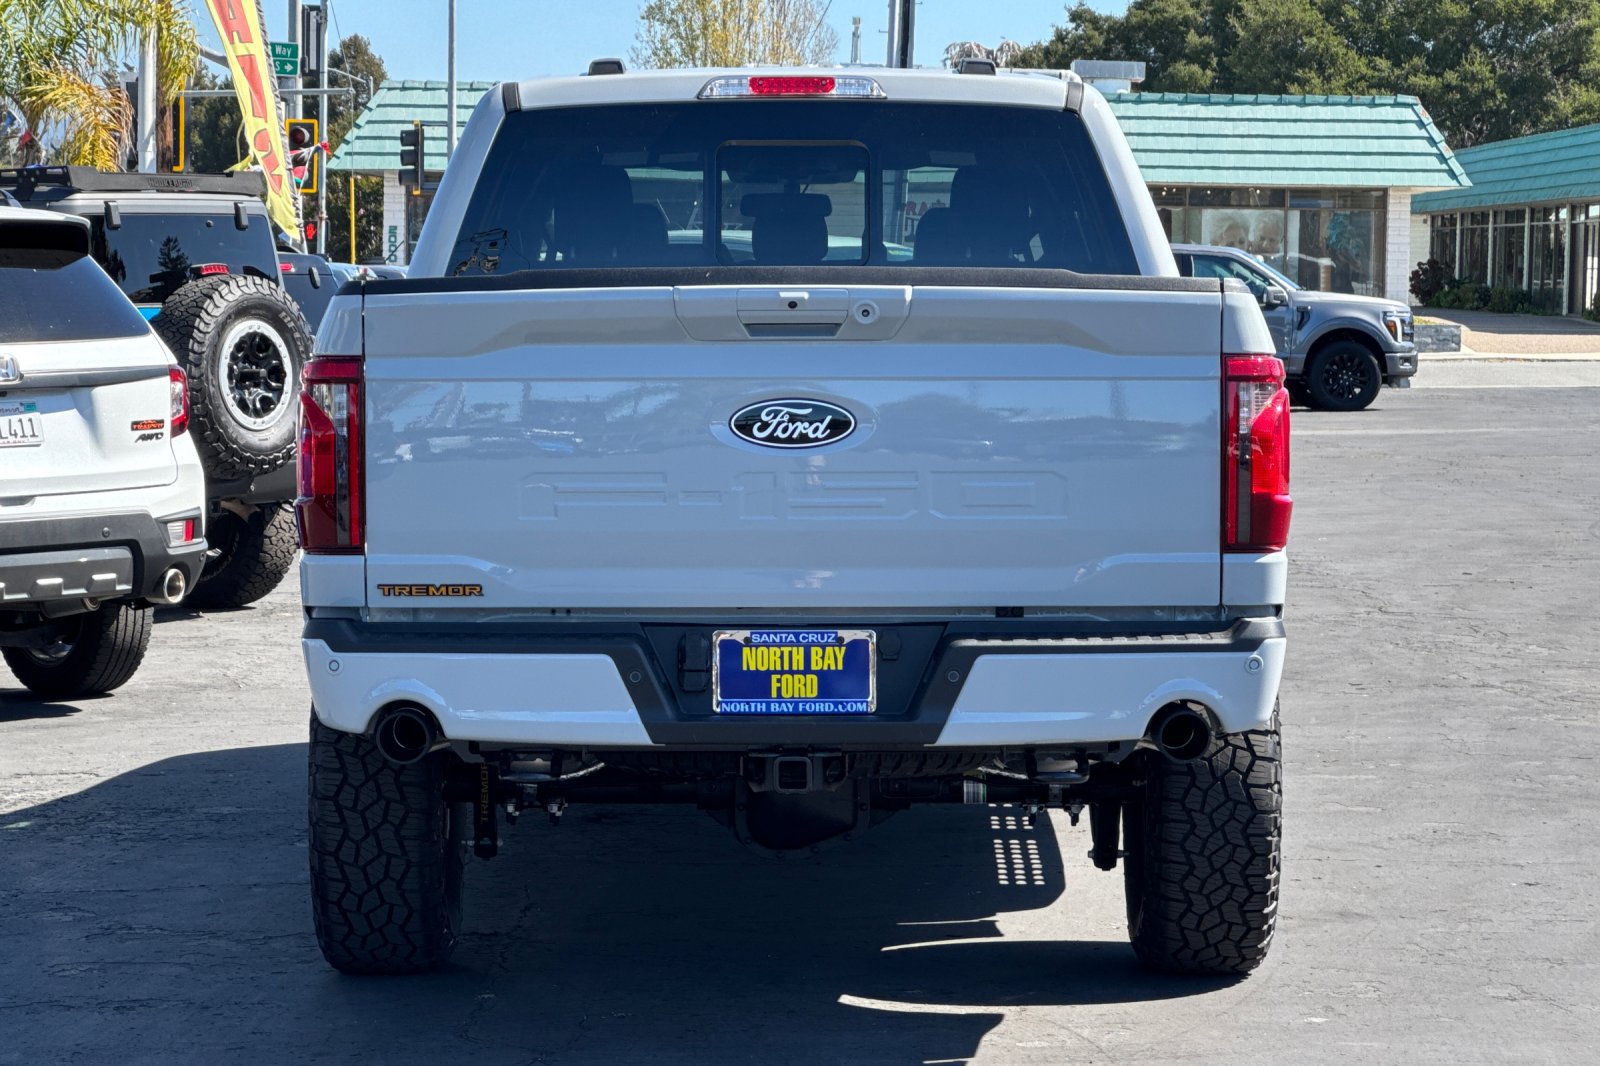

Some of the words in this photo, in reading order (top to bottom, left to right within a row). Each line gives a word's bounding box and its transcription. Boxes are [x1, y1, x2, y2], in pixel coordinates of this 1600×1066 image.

[275, 44, 292, 58] Way
[752, 404, 831, 441] Ford
[134, 432, 164, 443] AWD
[517, 470, 1069, 521] F-150
[377, 584, 484, 597] TREMOR
[751, 633, 797, 643] SANTA
[799, 633, 836, 643] CRUZ
[742, 646, 804, 671] NORTH
[811, 646, 846, 671] BAY
[771, 674, 818, 698] FORD
[721, 702, 766, 712] NORTH
[770, 702, 795, 712] BAY
[799, 702, 867, 712] FORD.COM
